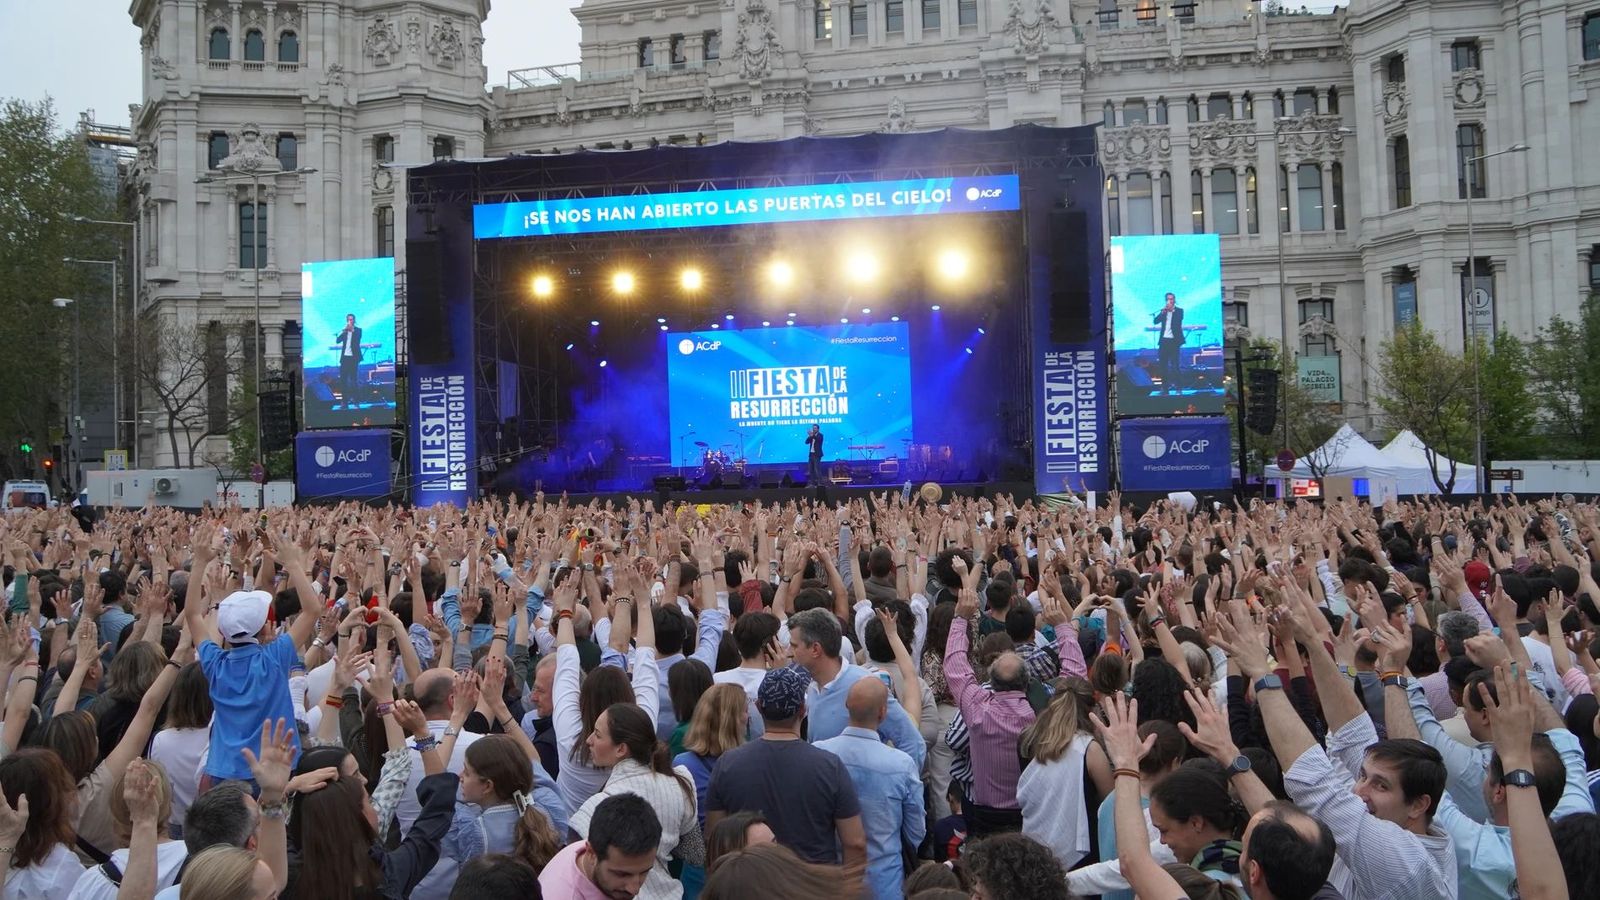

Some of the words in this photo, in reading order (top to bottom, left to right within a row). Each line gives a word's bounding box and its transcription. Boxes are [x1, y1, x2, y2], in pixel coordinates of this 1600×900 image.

[981, 188, 1003, 198] ACdP
[524, 211, 549, 229] ¡SE
[555, 208, 591, 224] NOS
[597, 206, 636, 221] HAN
[642, 201, 719, 219] ABIERTO
[725, 199, 758, 214] LAS
[765, 194, 845, 212] PUERTAS
[852, 193, 885, 207] DEL
[892, 188, 952, 205] CIELO!
[695, 340, 722, 351] ACdP
[1045, 352, 1058, 366] DE
[1059, 351, 1072, 365] LA
[420, 377, 432, 390] DE
[433, 376, 445, 390] LA
[748, 367, 829, 396] FIESTA
[833, 366, 847, 380] DE
[834, 380, 847, 393] LA
[730, 393, 848, 419] RESURRECCIÓN
[1046, 370, 1075, 455] FIESTA
[1073, 351, 1098, 473] RESURRECCIÓN
[421, 394, 446, 473] FIESTA
[447, 375, 467, 490] RESURRECCIÓN
[1169, 440, 1210, 454] ACdP
[337, 449, 371, 463] ACdP
